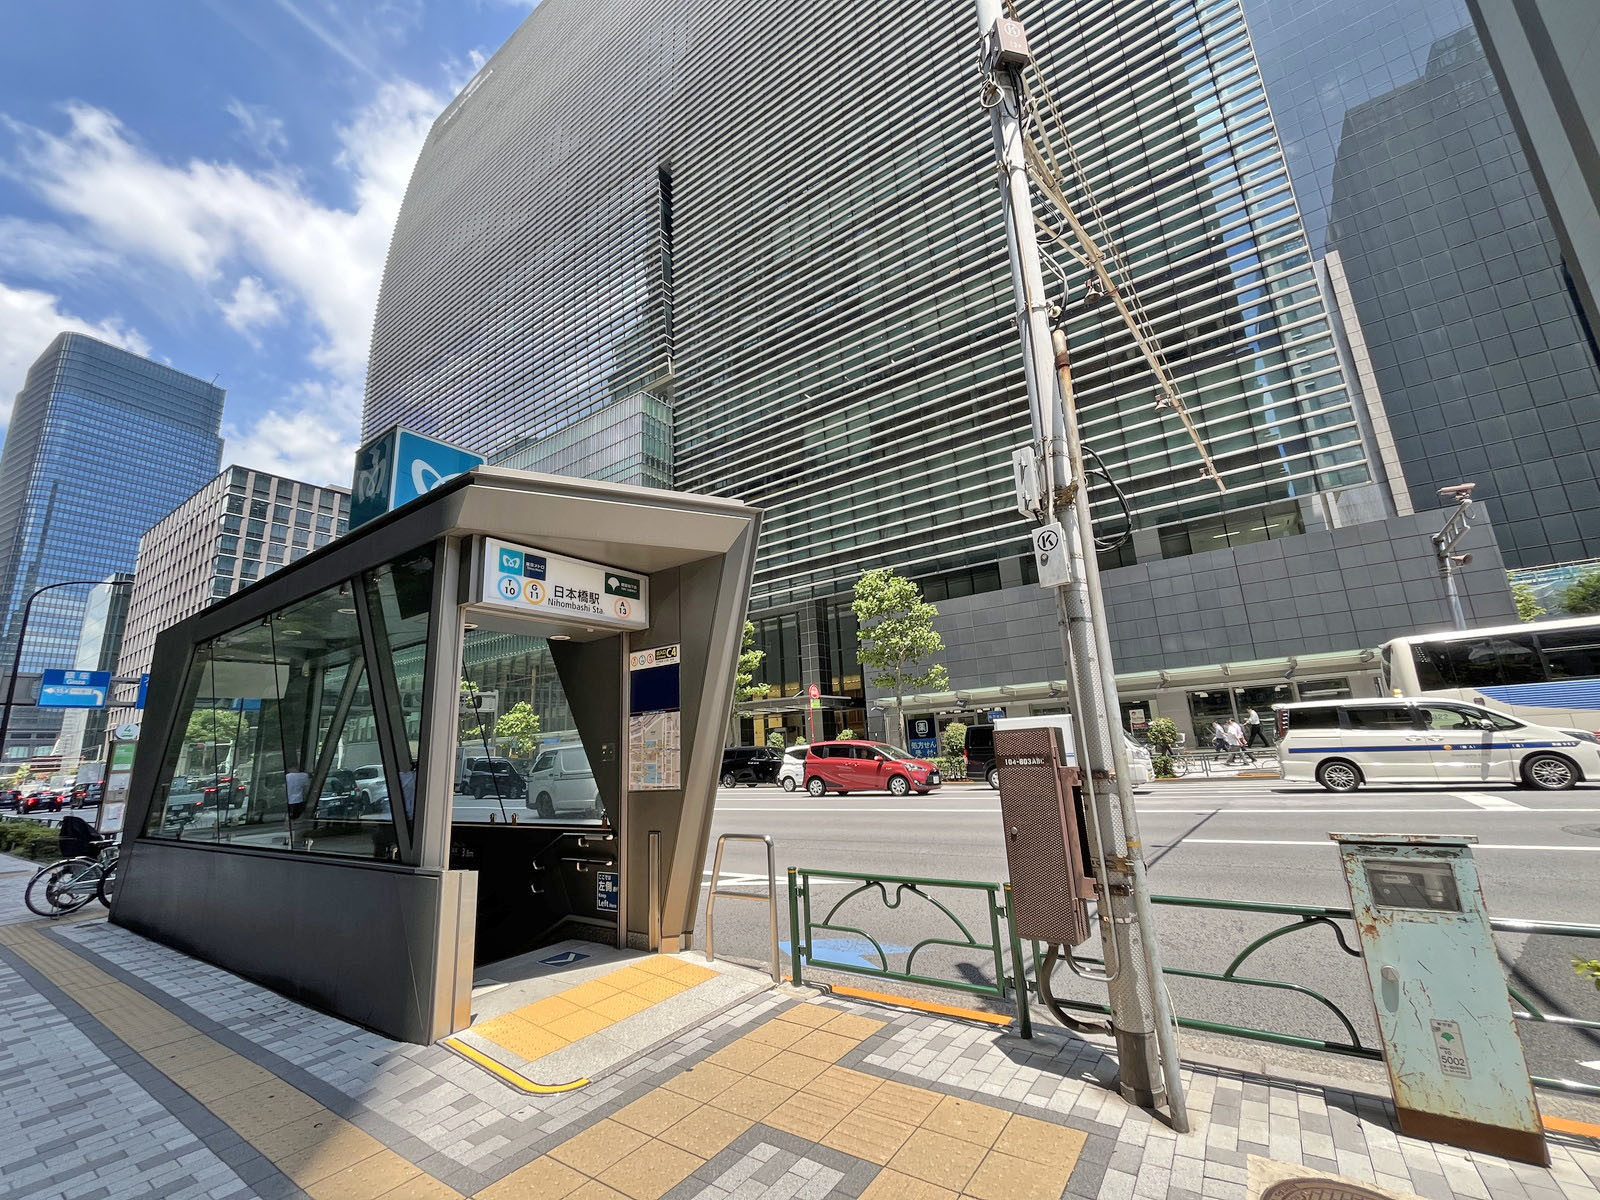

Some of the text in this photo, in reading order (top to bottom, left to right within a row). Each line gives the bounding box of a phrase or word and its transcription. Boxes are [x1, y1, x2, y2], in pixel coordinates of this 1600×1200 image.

[1042, 533, 1054, 548] K
[504, 587, 516, 596] 10
[554, 585, 600, 605] 日本橋駅
[548, 598, 605, 615] Nihombashi Sta.
[666, 648, 678, 658] C4
[598, 900, 608, 908] Left
[1442, 1056, 1466, 1066] 5002
